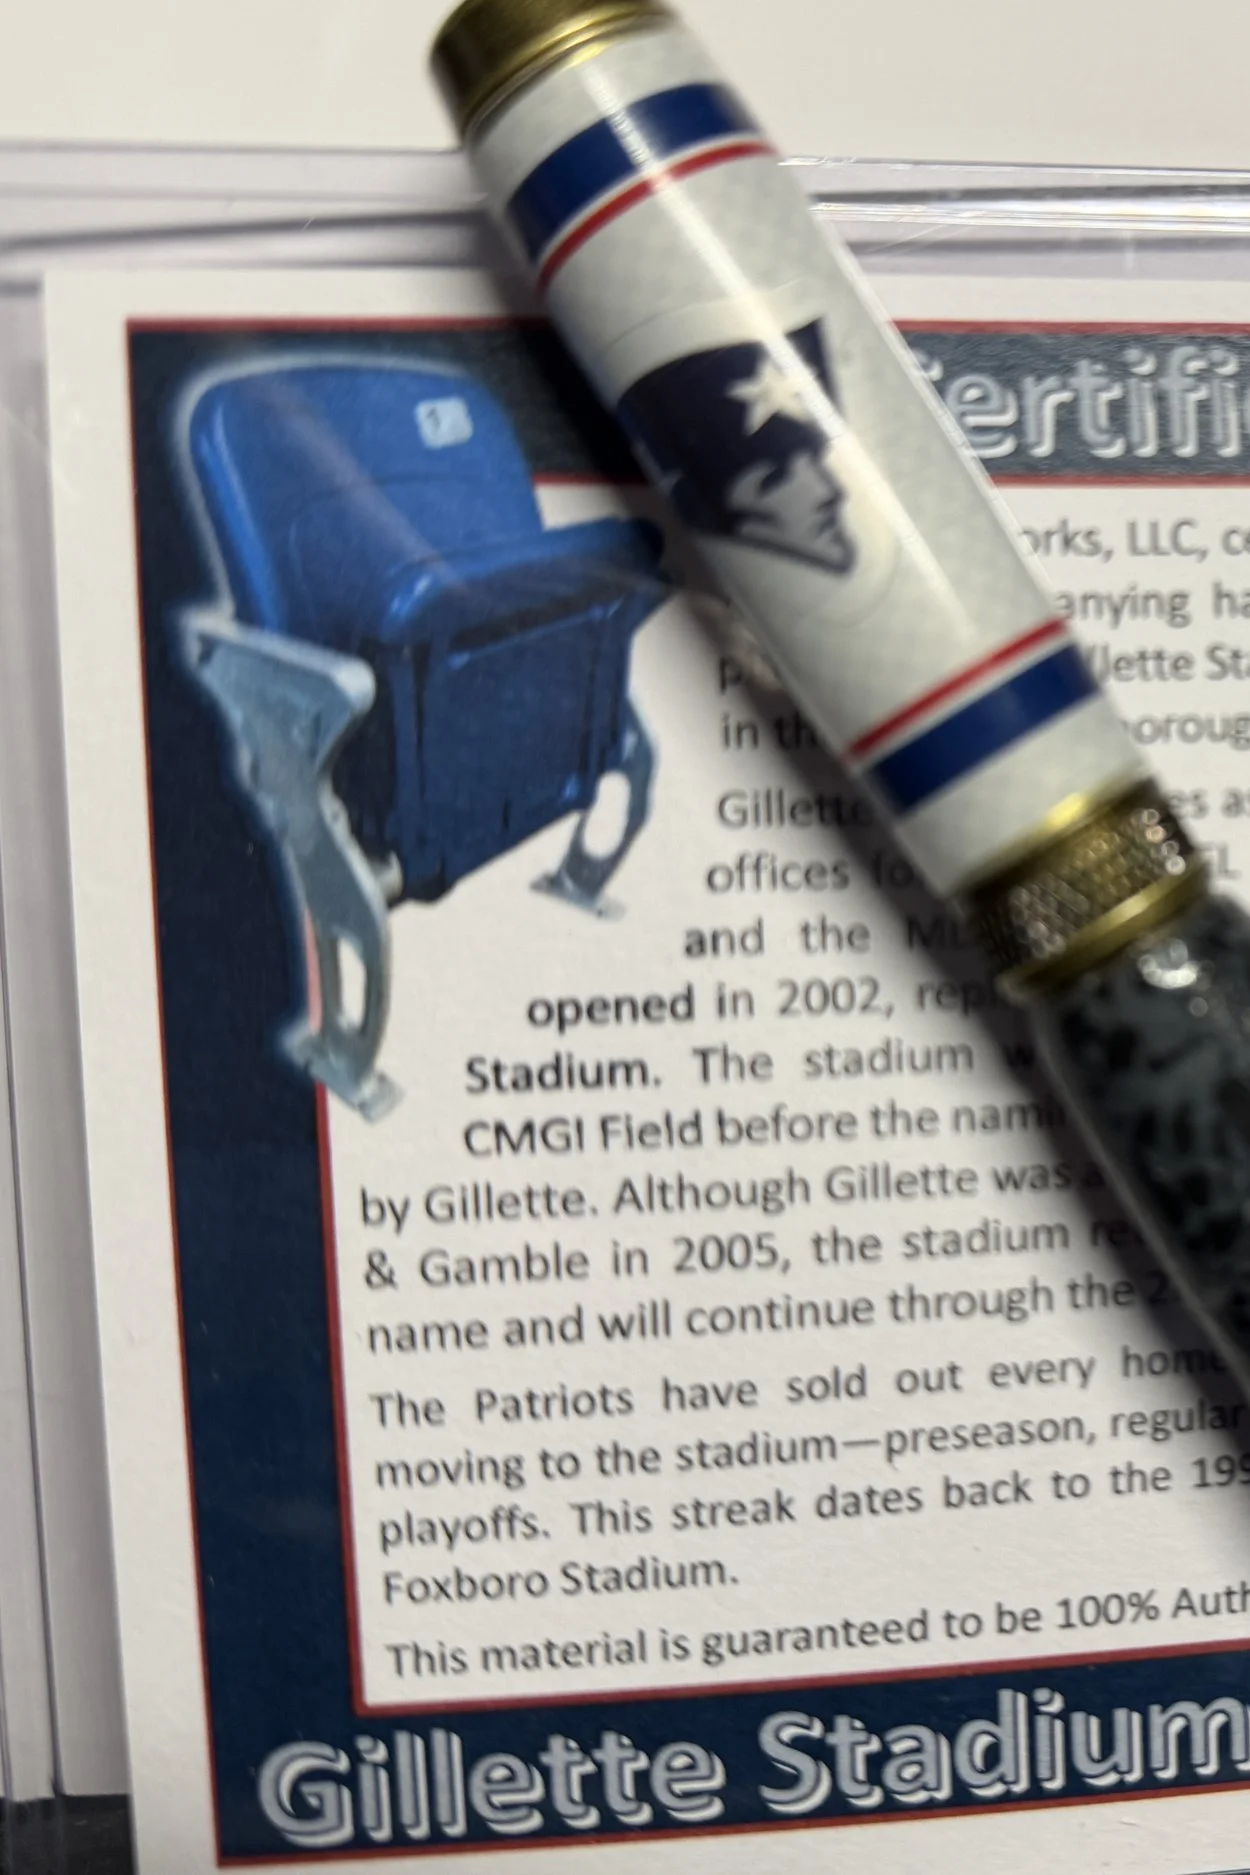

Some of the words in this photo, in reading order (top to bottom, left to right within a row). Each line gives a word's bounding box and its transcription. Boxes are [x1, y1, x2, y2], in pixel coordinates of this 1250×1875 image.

[1019, 519, 1115, 563] orks,
[1128, 518, 1208, 562] LLC,
[1057, 586, 1191, 630] anying
[1088, 642, 1195, 683] lette
[722, 713, 759, 749] in
[772, 708, 821, 749] th
[716, 788, 875, 830] Gillette
[705, 852, 850, 894] offices
[684, 916, 764, 959] and
[799, 914, 870, 954] the
[526, 981, 695, 1037] opened
[715, 982, 755, 1020] in
[778, 976, 894, 1019] 2002,
[465, 1051, 662, 1096] Stadium.
[692, 1043, 773, 1085] The
[804, 1037, 973, 1079] stadium
[462, 1116, 584, 1158] CMGI
[599, 1109, 703, 1152] Field
[715, 1103, 858, 1146] before
[869, 1099, 939, 1140] the
[360, 1186, 411, 1236] by
[424, 1181, 598, 1224] Gillette.
[612, 1166, 811, 1216] Although
[824, 1162, 978, 1203] Gillette
[991, 1160, 1071, 1193] was
[364, 1249, 398, 1290] &
[418, 1241, 589, 1288] Gamble
[612, 1240, 649, 1278] in
[673, 1232, 791, 1275] 2005,
[810, 1226, 882, 1266] the
[902, 1218, 1069, 1261] stadium
[367, 1320, 489, 1355] name
[503, 1303, 584, 1348] and
[597, 1298, 671, 1341] will
[685, 1294, 875, 1337] continue
[886, 1276, 1054, 1324] through
[1067, 1271, 1136, 1309] the
[369, 1391, 445, 1429] The
[475, 1383, 634, 1424] Patriots
[661, 1376, 758, 1412] have
[786, 1363, 867, 1404] sold
[894, 1361, 963, 1396] out
[988, 1357, 1096, 1389] every
[375, 1449, 526, 1491] moving
[538, 1448, 581, 1481] to
[594, 1440, 662, 1478] the
[1110, 1398, 1247, 1443] regular
[379, 1504, 551, 1556] playoffs.
[569, 1499, 653, 1536] This
[672, 1488, 796, 1531] streak
[814, 1484, 924, 1520] dates
[943, 1470, 1033, 1509] back
[1050, 1471, 1091, 1500] to
[1108, 1461, 1172, 1496] the
[383, 1566, 550, 1605] Foxboro
[560, 1556, 739, 1596] Stadium.
[385, 1641, 469, 1678] This
[480, 1629, 647, 1673] material
[659, 1626, 691, 1661] is
[701, 1608, 930, 1668] guaranteed
[942, 1610, 984, 1640] to
[995, 1602, 1043, 1635] be
[1057, 1589, 1161, 1630] 100%
[256, 1725, 729, 1848] Gillette
